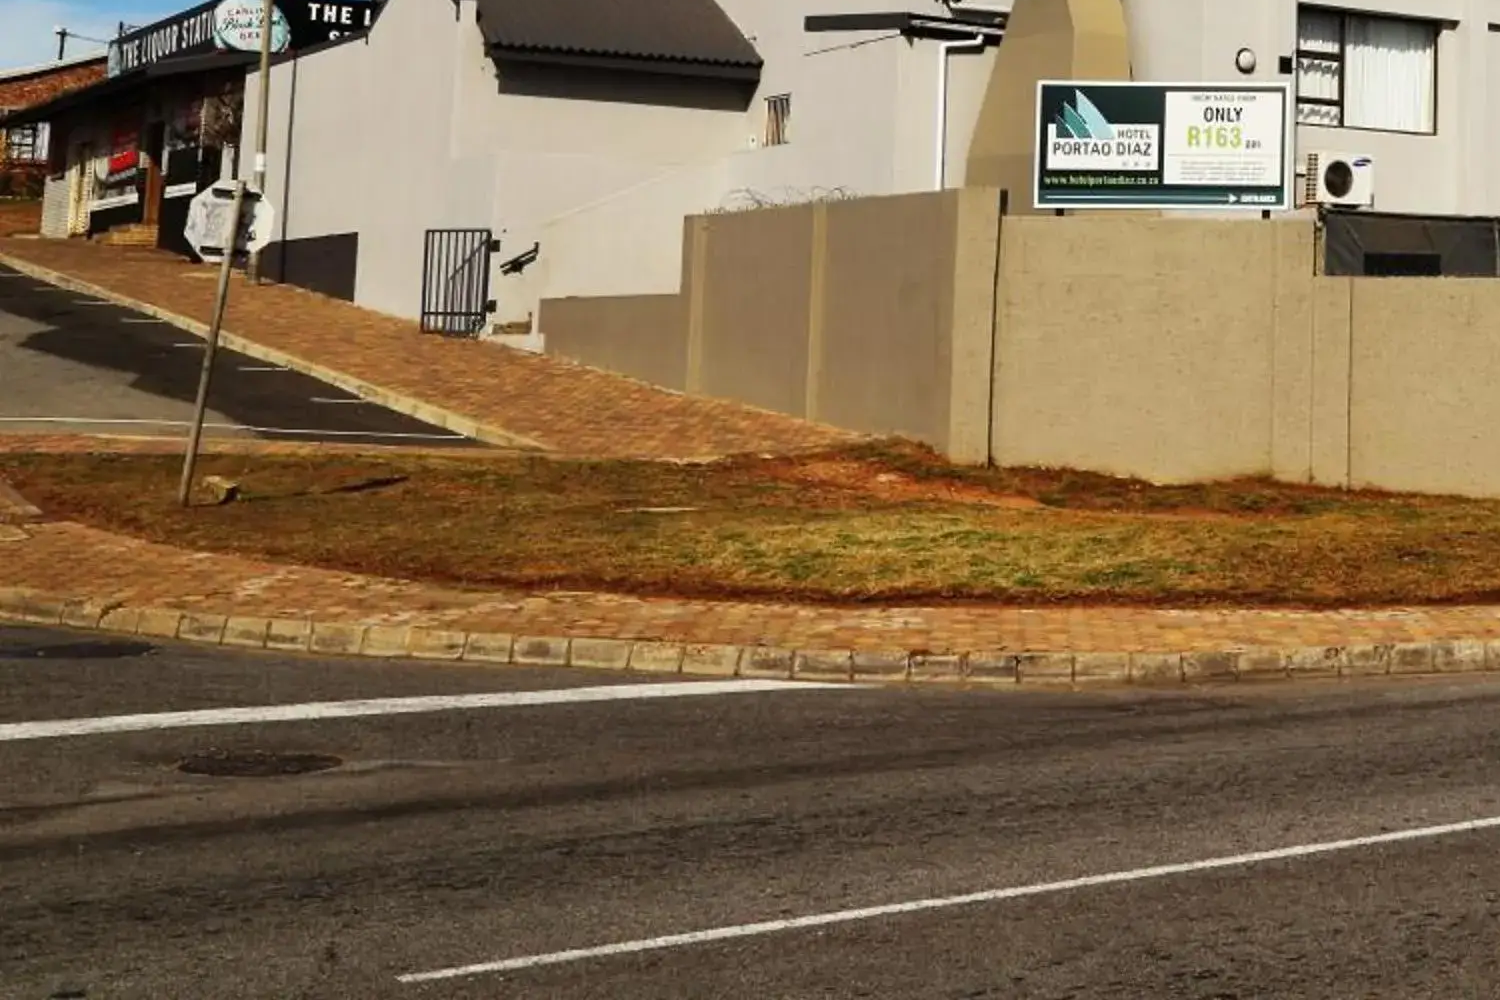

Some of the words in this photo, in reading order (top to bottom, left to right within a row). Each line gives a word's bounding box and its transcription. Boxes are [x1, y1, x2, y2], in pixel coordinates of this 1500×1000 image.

[227, 7, 265, 16] CARLIN
[308, 3, 353, 24] THE
[122, 39, 139, 71] THE
[142, 23, 179, 64] LIQUOR
[182, 9, 217, 49] STATI
[239, 31, 260, 40] BEE
[1203, 106, 1243, 123] ONLY
[1117, 128, 1152, 139] HOTEL
[1187, 125, 1242, 148] R163
[1116, 142, 1152, 156] DIAZ
